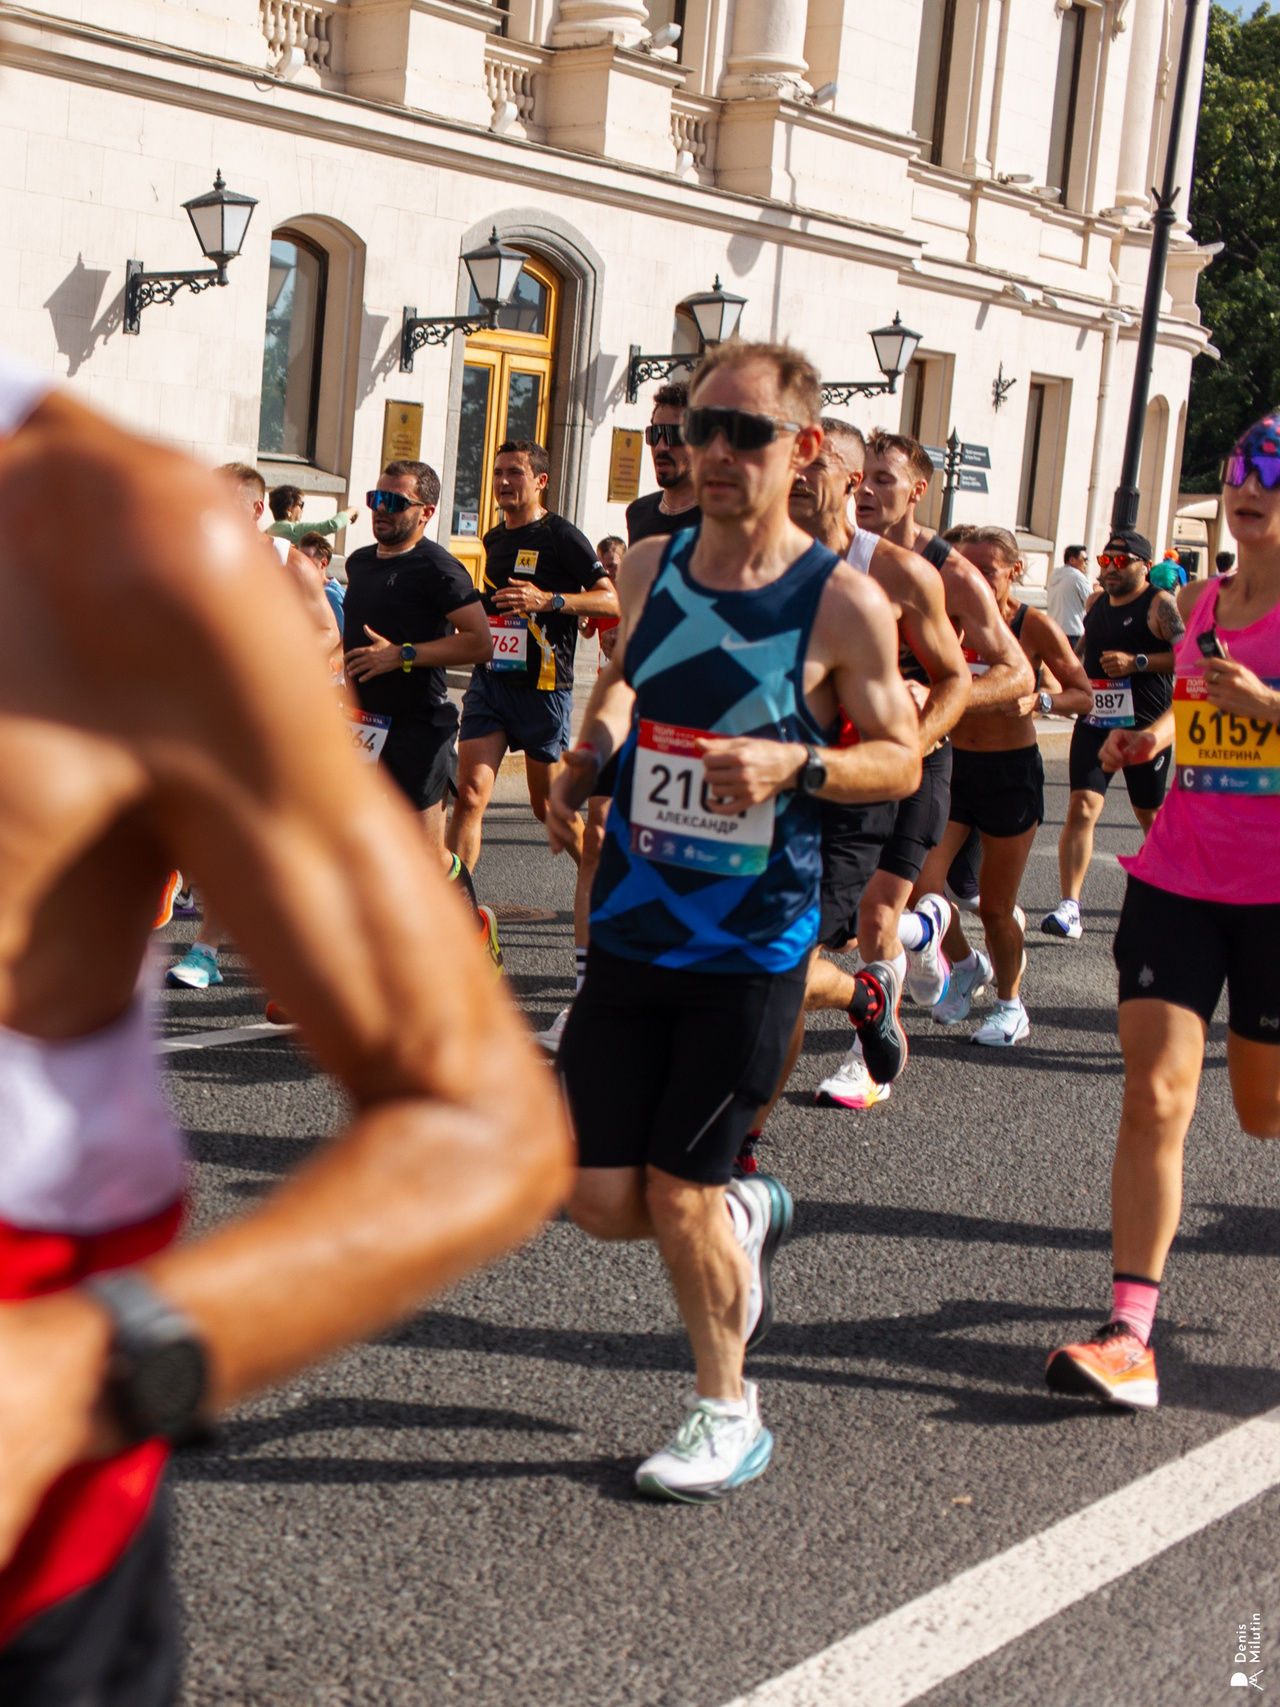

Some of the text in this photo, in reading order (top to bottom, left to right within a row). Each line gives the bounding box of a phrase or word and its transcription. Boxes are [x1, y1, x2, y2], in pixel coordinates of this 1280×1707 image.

[1095, 693, 1124, 709] 887
[1189, 710, 1280, 747] 6159
[1198, 749, 1261, 761] ЕКАТЕРИНА
[656, 809, 739, 835] АЛЕКСАНДР
